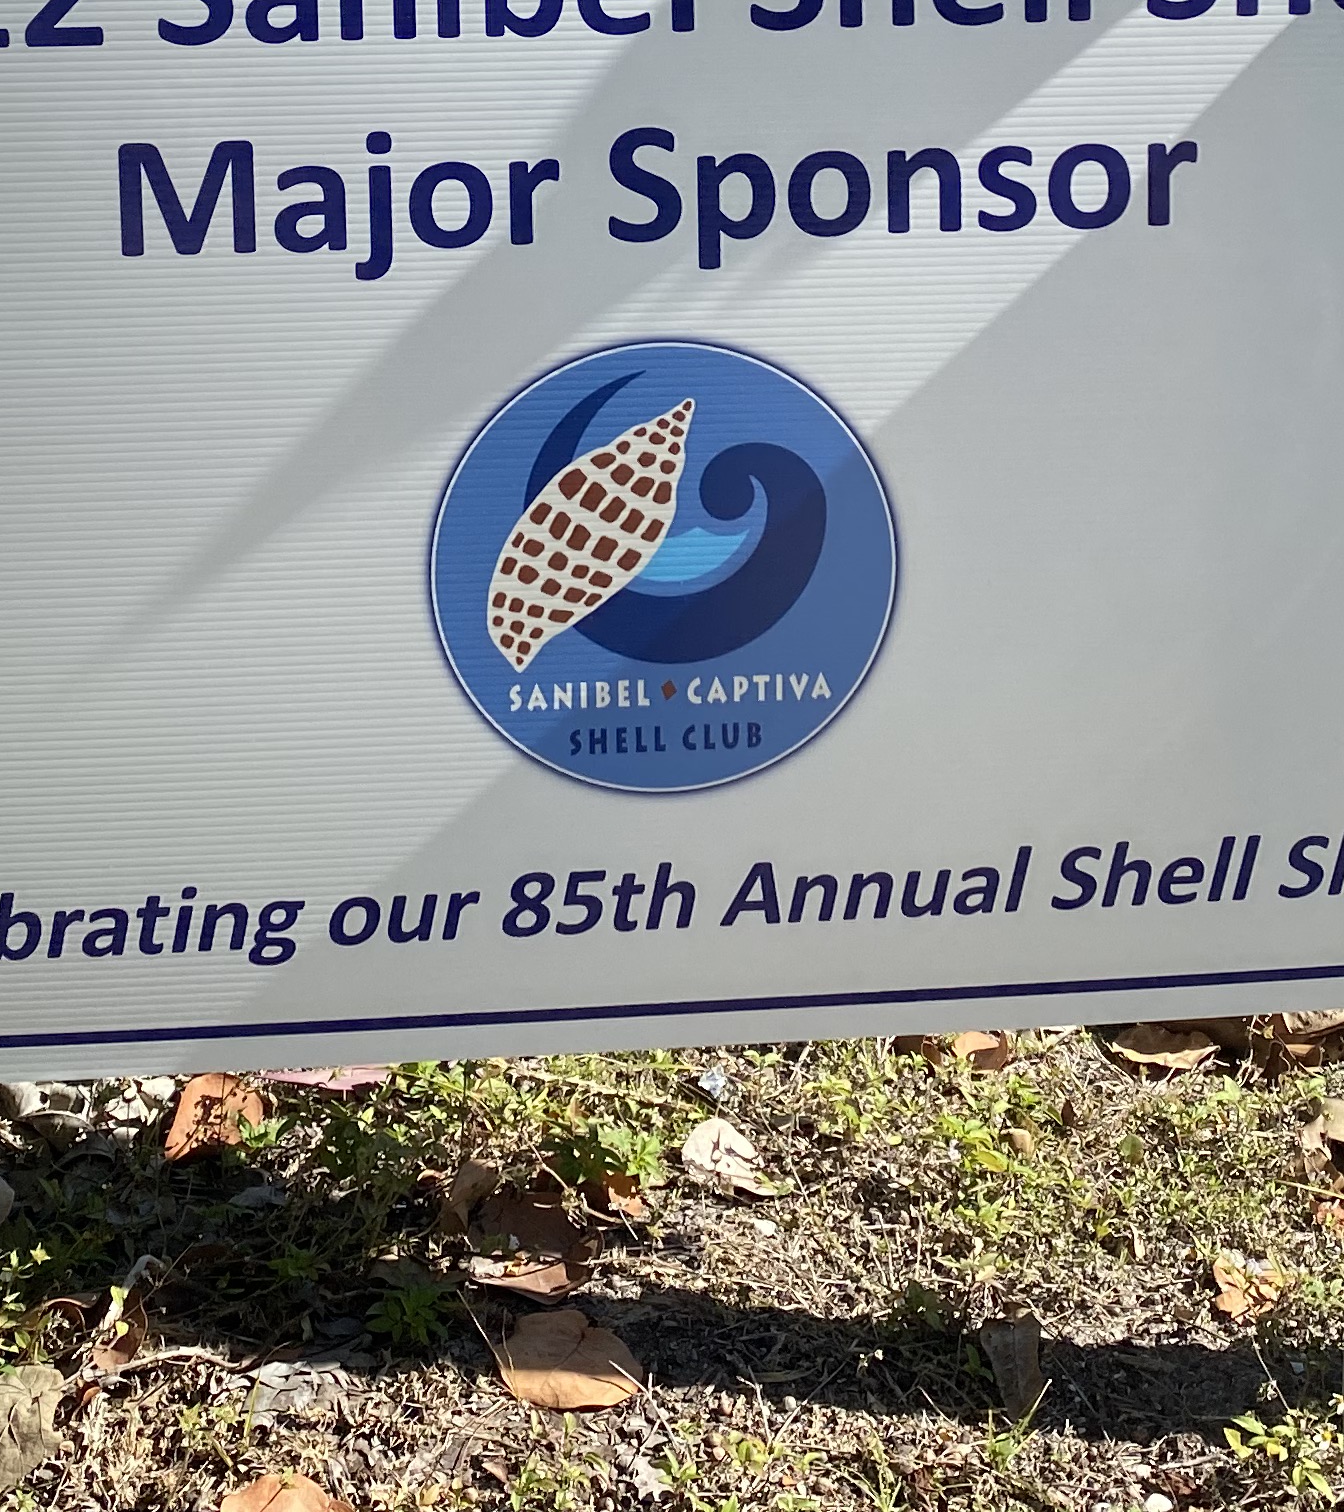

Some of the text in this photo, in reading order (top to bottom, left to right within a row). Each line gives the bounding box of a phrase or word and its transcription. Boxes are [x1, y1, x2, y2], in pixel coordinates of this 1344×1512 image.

[117, 126, 1198, 281] Major Sponsor
[509, 671, 832, 712] SANIBEL CAPTIVA
[569, 721, 762, 756] SHELL CLUB
[328, 890, 481, 946] our
[501, 861, 696, 938] 85th
[719, 845, 1032, 927] Annual
[1050, 834, 1261, 911] Shell
